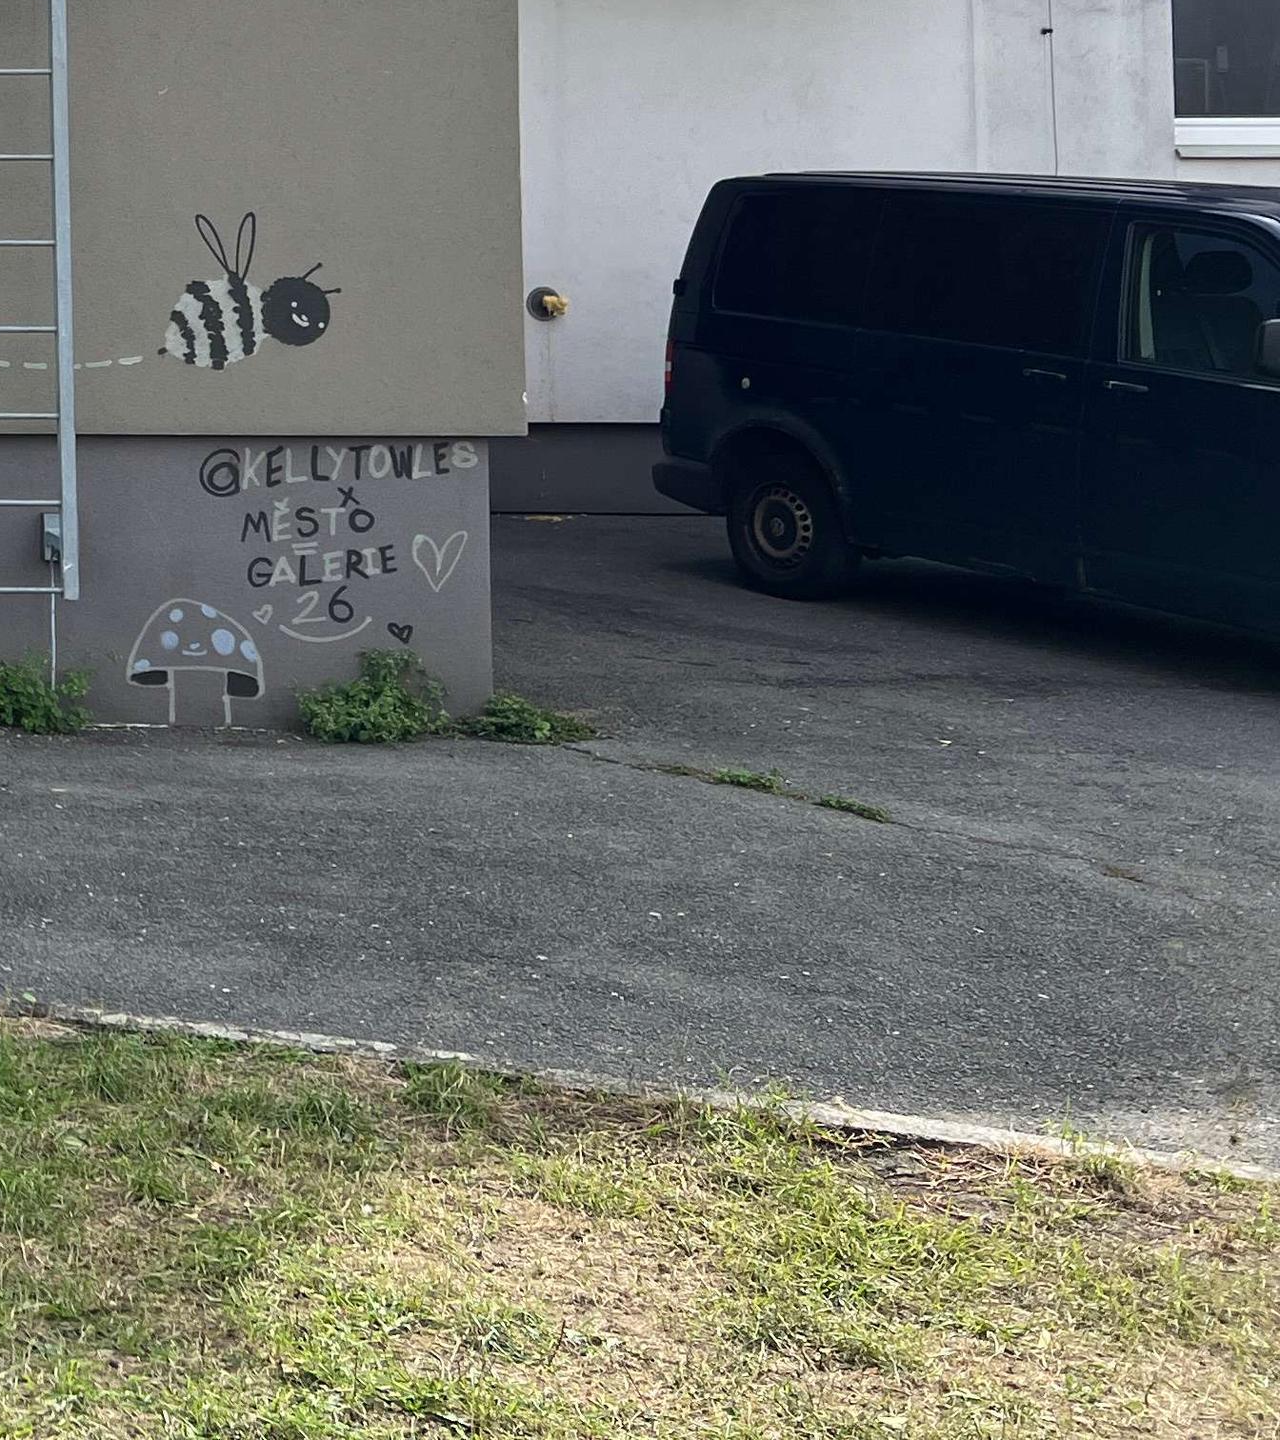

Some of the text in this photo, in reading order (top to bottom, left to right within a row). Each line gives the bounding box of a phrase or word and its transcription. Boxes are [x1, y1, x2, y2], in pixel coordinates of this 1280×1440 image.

[199, 441, 479, 497] @KELLYTOWLES
[241, 498, 375, 542] MĚSTO
[247, 545, 398, 588] GALERIE
[292, 586, 355, 624] 26
